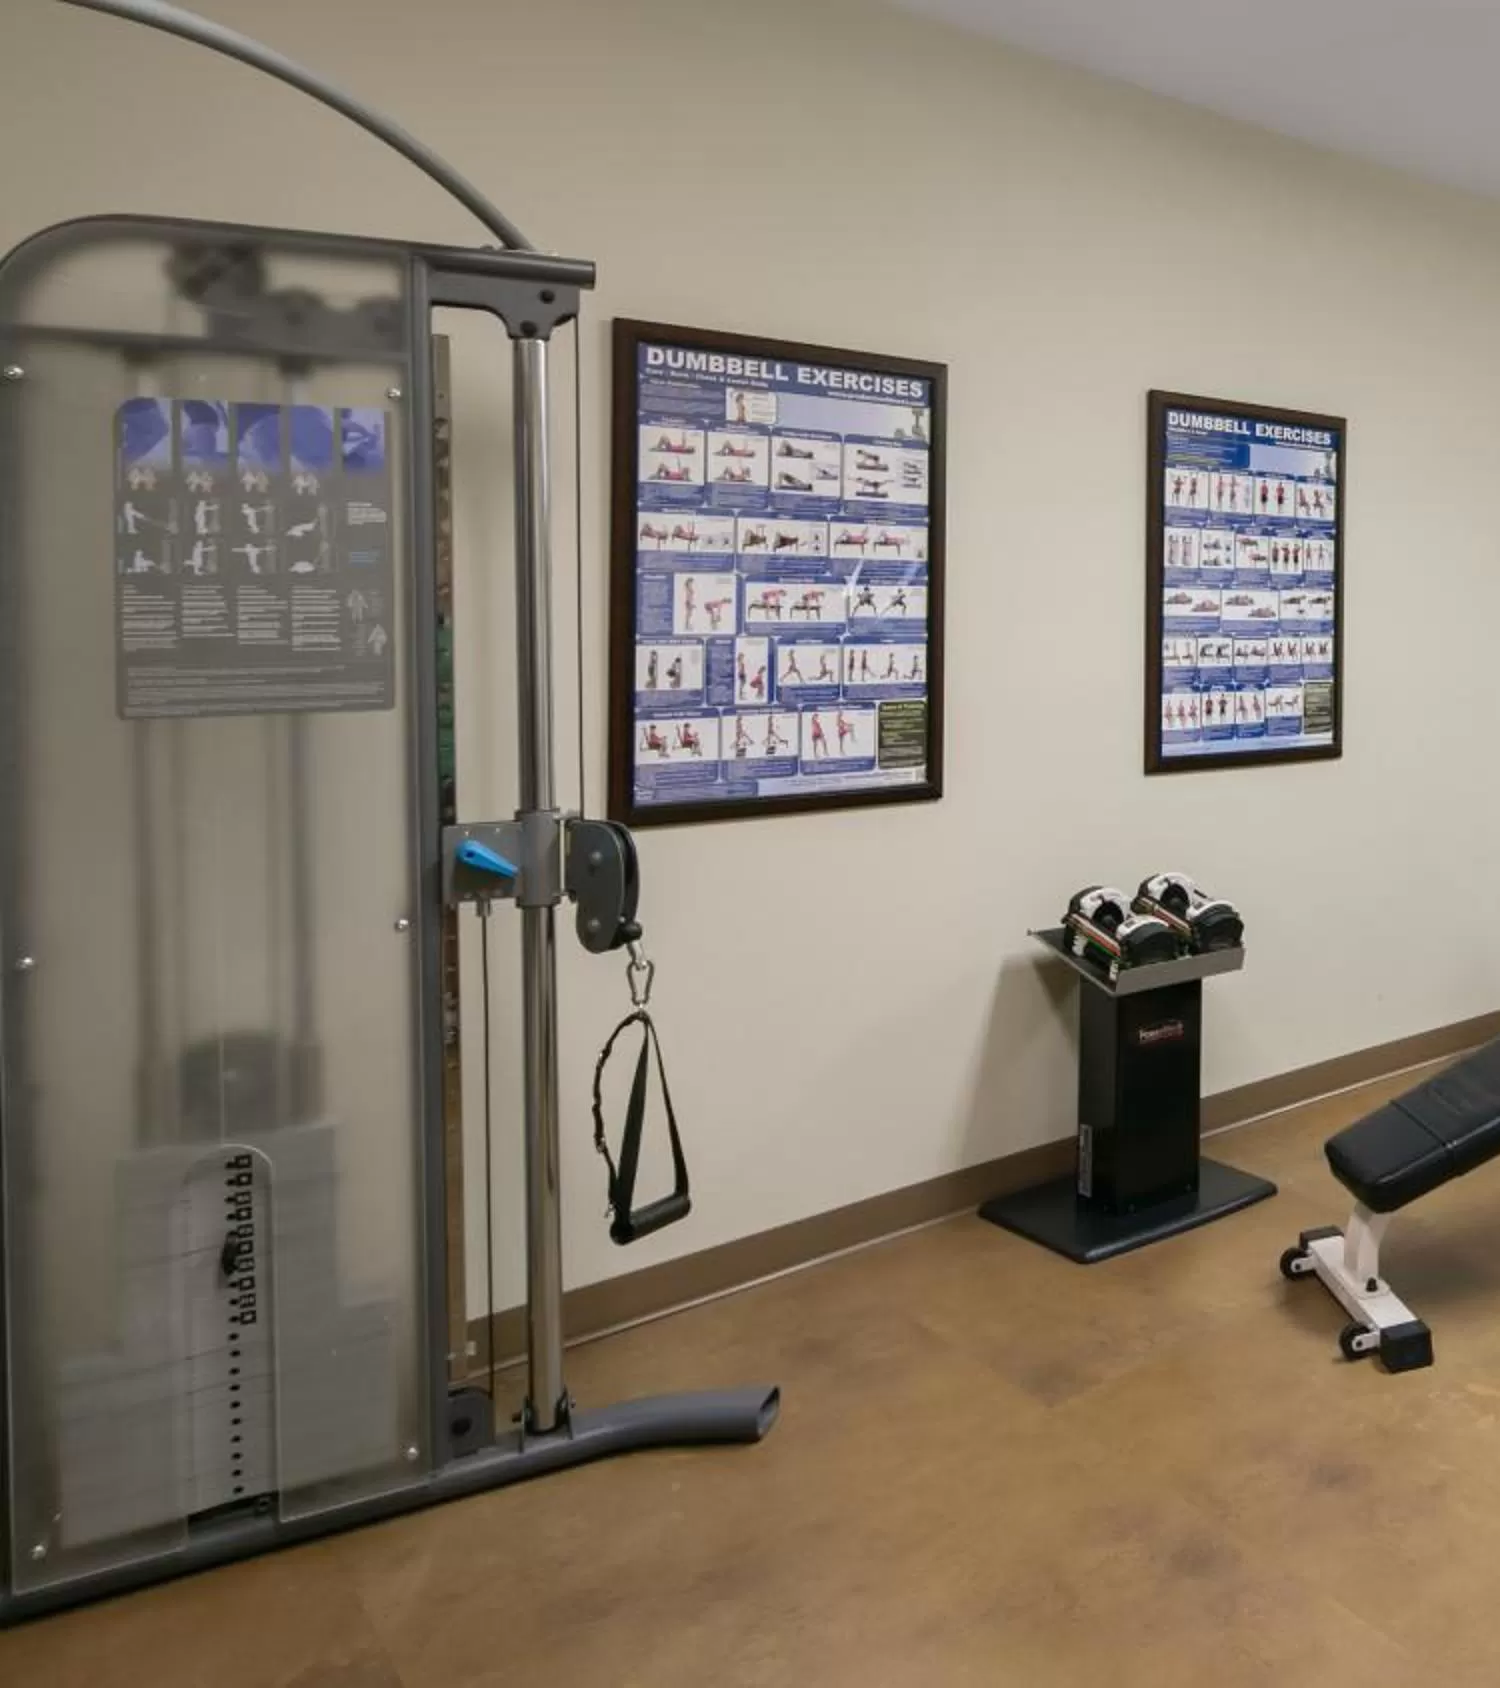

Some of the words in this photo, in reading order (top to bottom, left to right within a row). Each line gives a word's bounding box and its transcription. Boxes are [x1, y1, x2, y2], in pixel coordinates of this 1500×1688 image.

[646, 346, 789, 382] DUMBBELL
[797, 365, 923, 398] EXERCISES
[1167, 411, 1250, 436] DUMBBELL
[1255, 422, 1332, 446] EXERCISES
